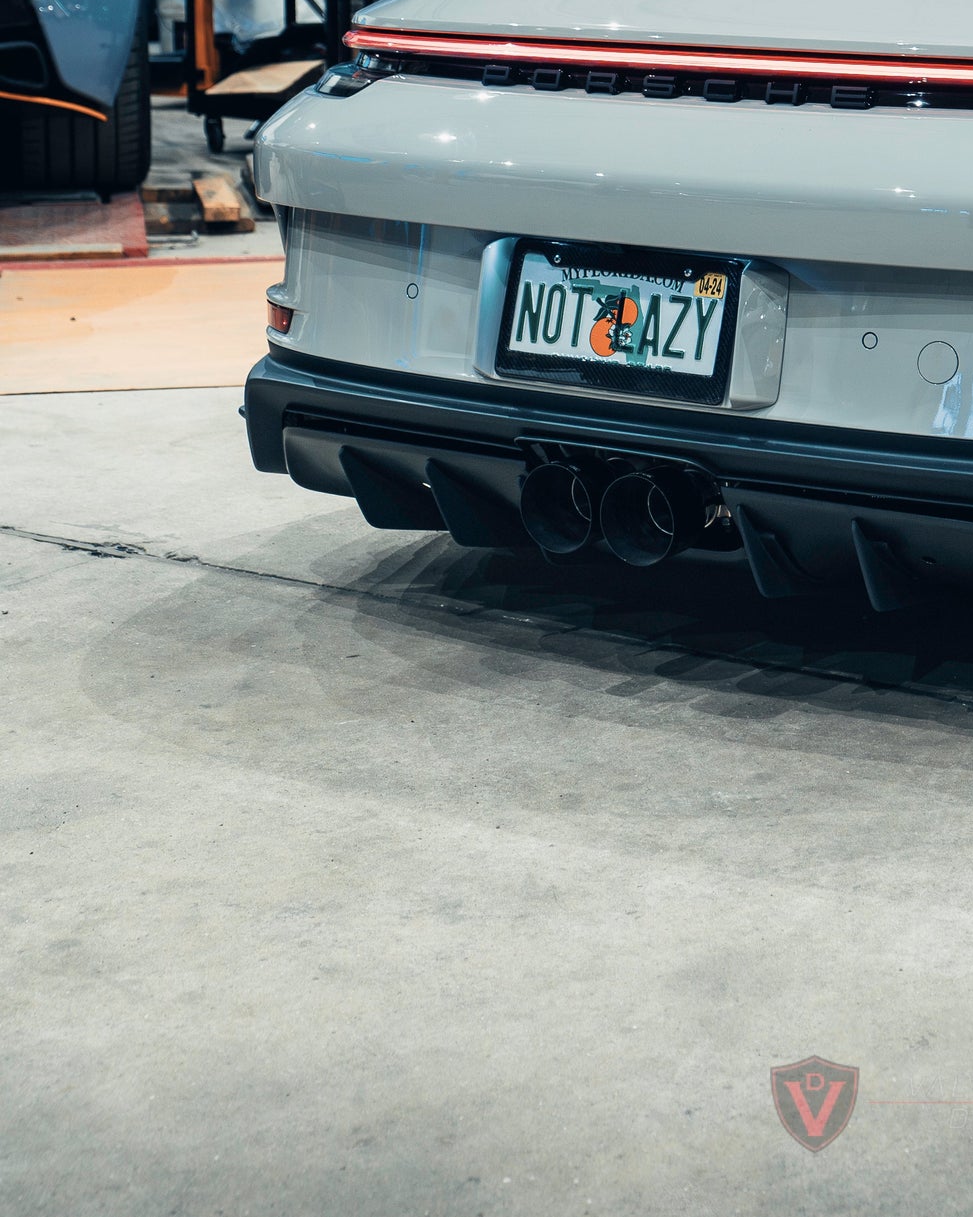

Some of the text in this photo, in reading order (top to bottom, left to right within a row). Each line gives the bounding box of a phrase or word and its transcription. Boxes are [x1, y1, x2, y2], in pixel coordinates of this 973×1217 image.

[481, 64, 873, 109] PORSCHE
[561, 267, 685, 293] MYFLA.COM
[699, 276, 723, 295] 04-24
[516, 281, 718, 361] NOT LAZY
